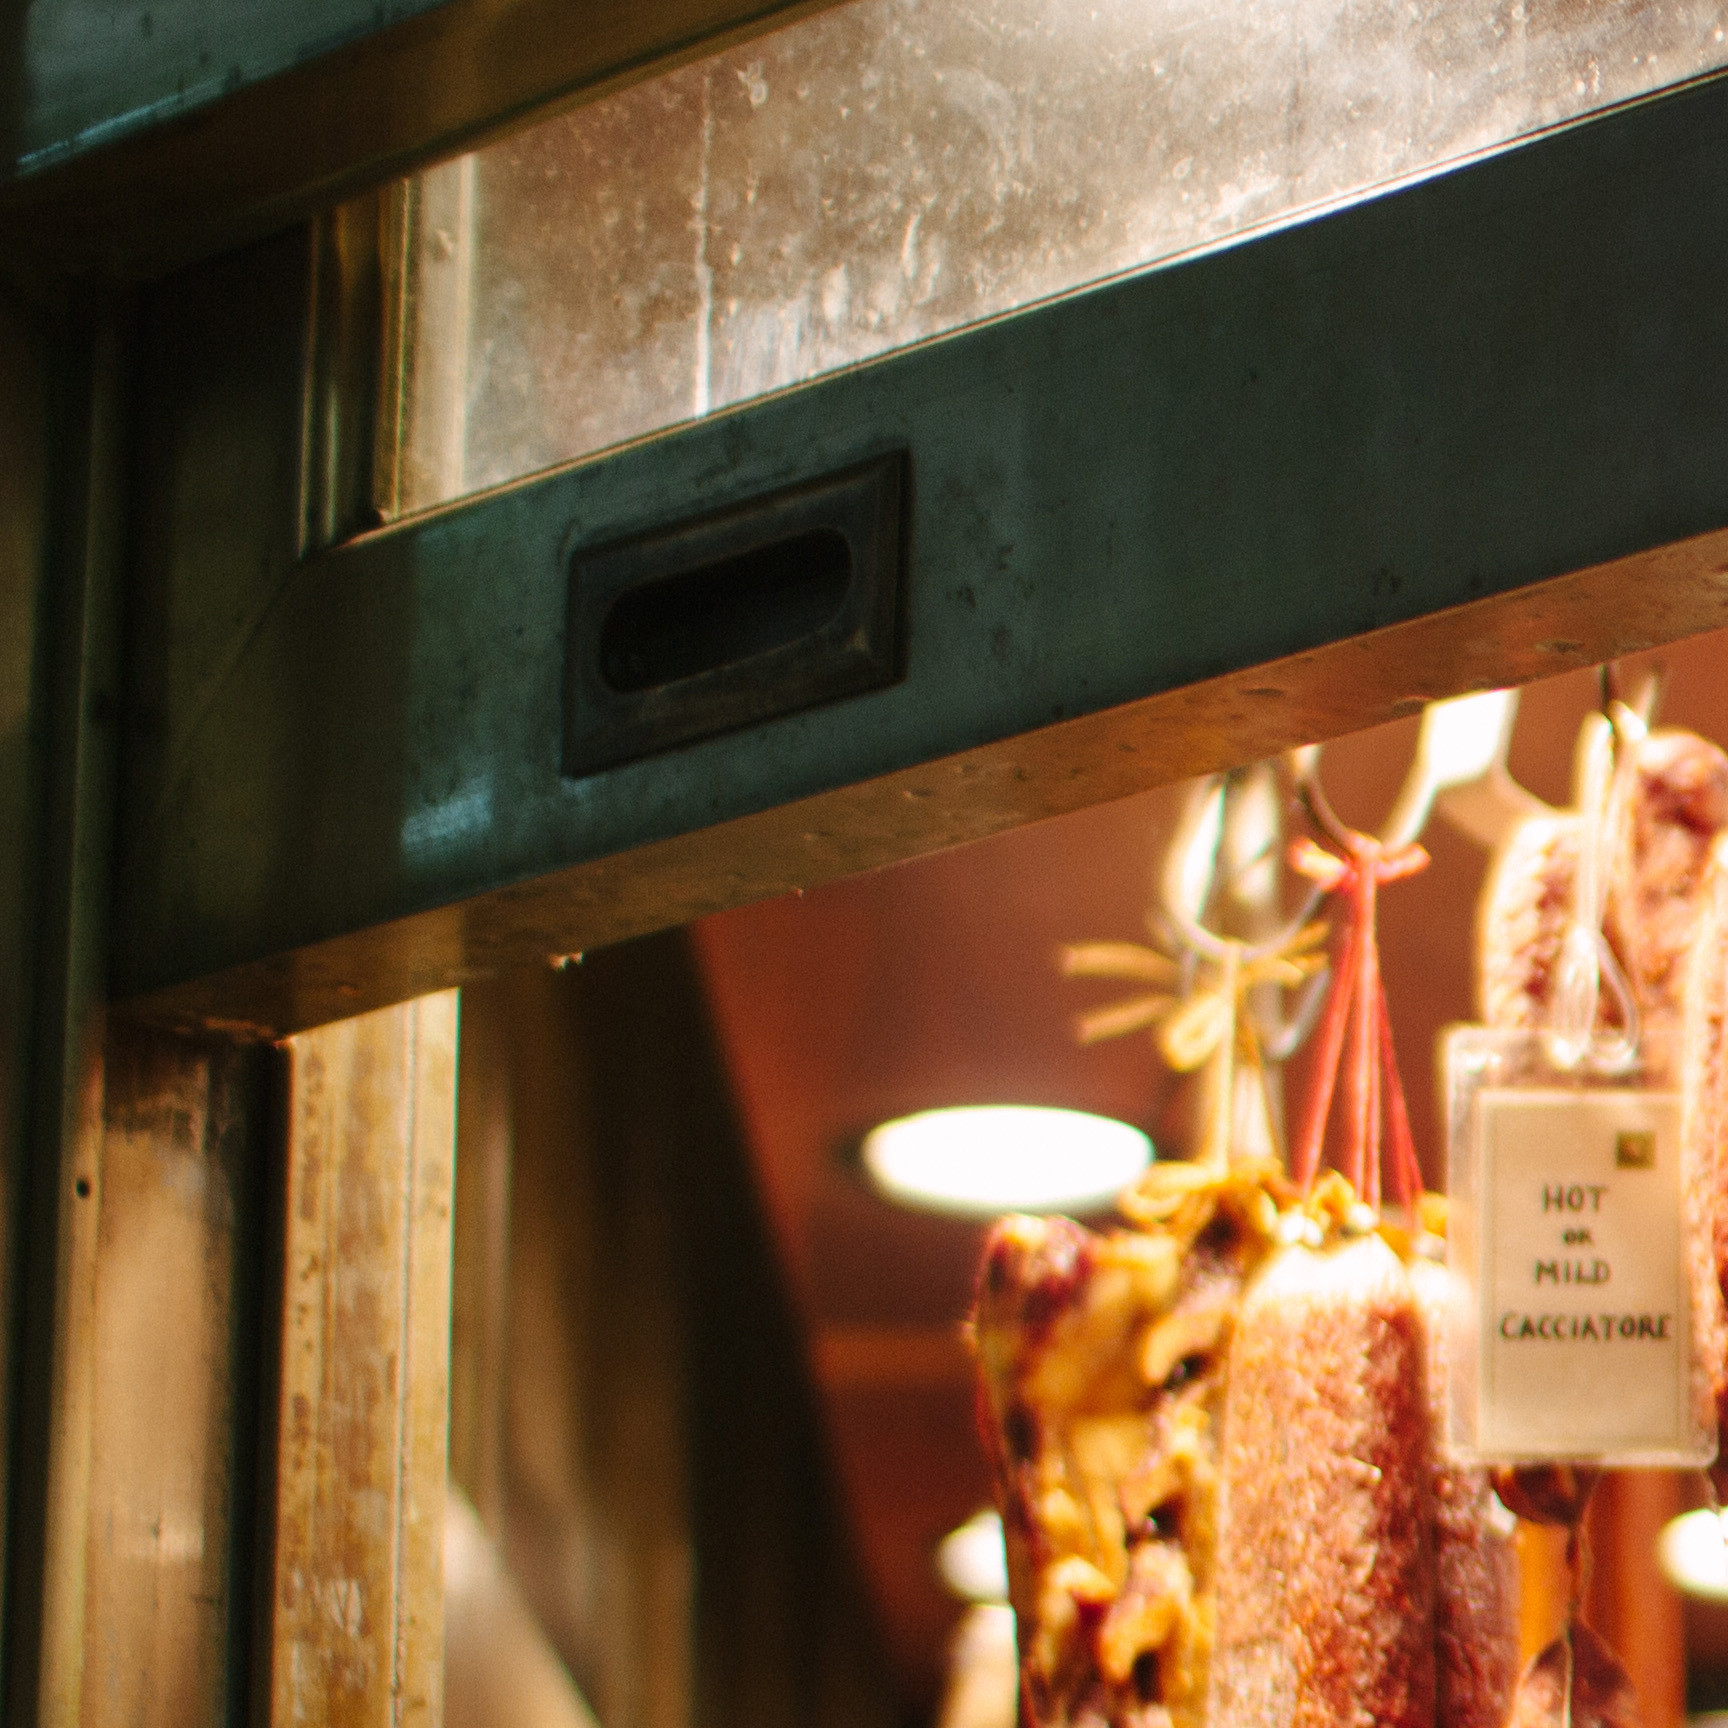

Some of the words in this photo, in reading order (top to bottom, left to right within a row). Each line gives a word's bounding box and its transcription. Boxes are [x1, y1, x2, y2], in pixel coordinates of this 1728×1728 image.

[1541, 1185, 1607, 1214] HOT
[1534, 1261, 1611, 1285] MILD
[1500, 1313, 1671, 1342] CACCIATORE
